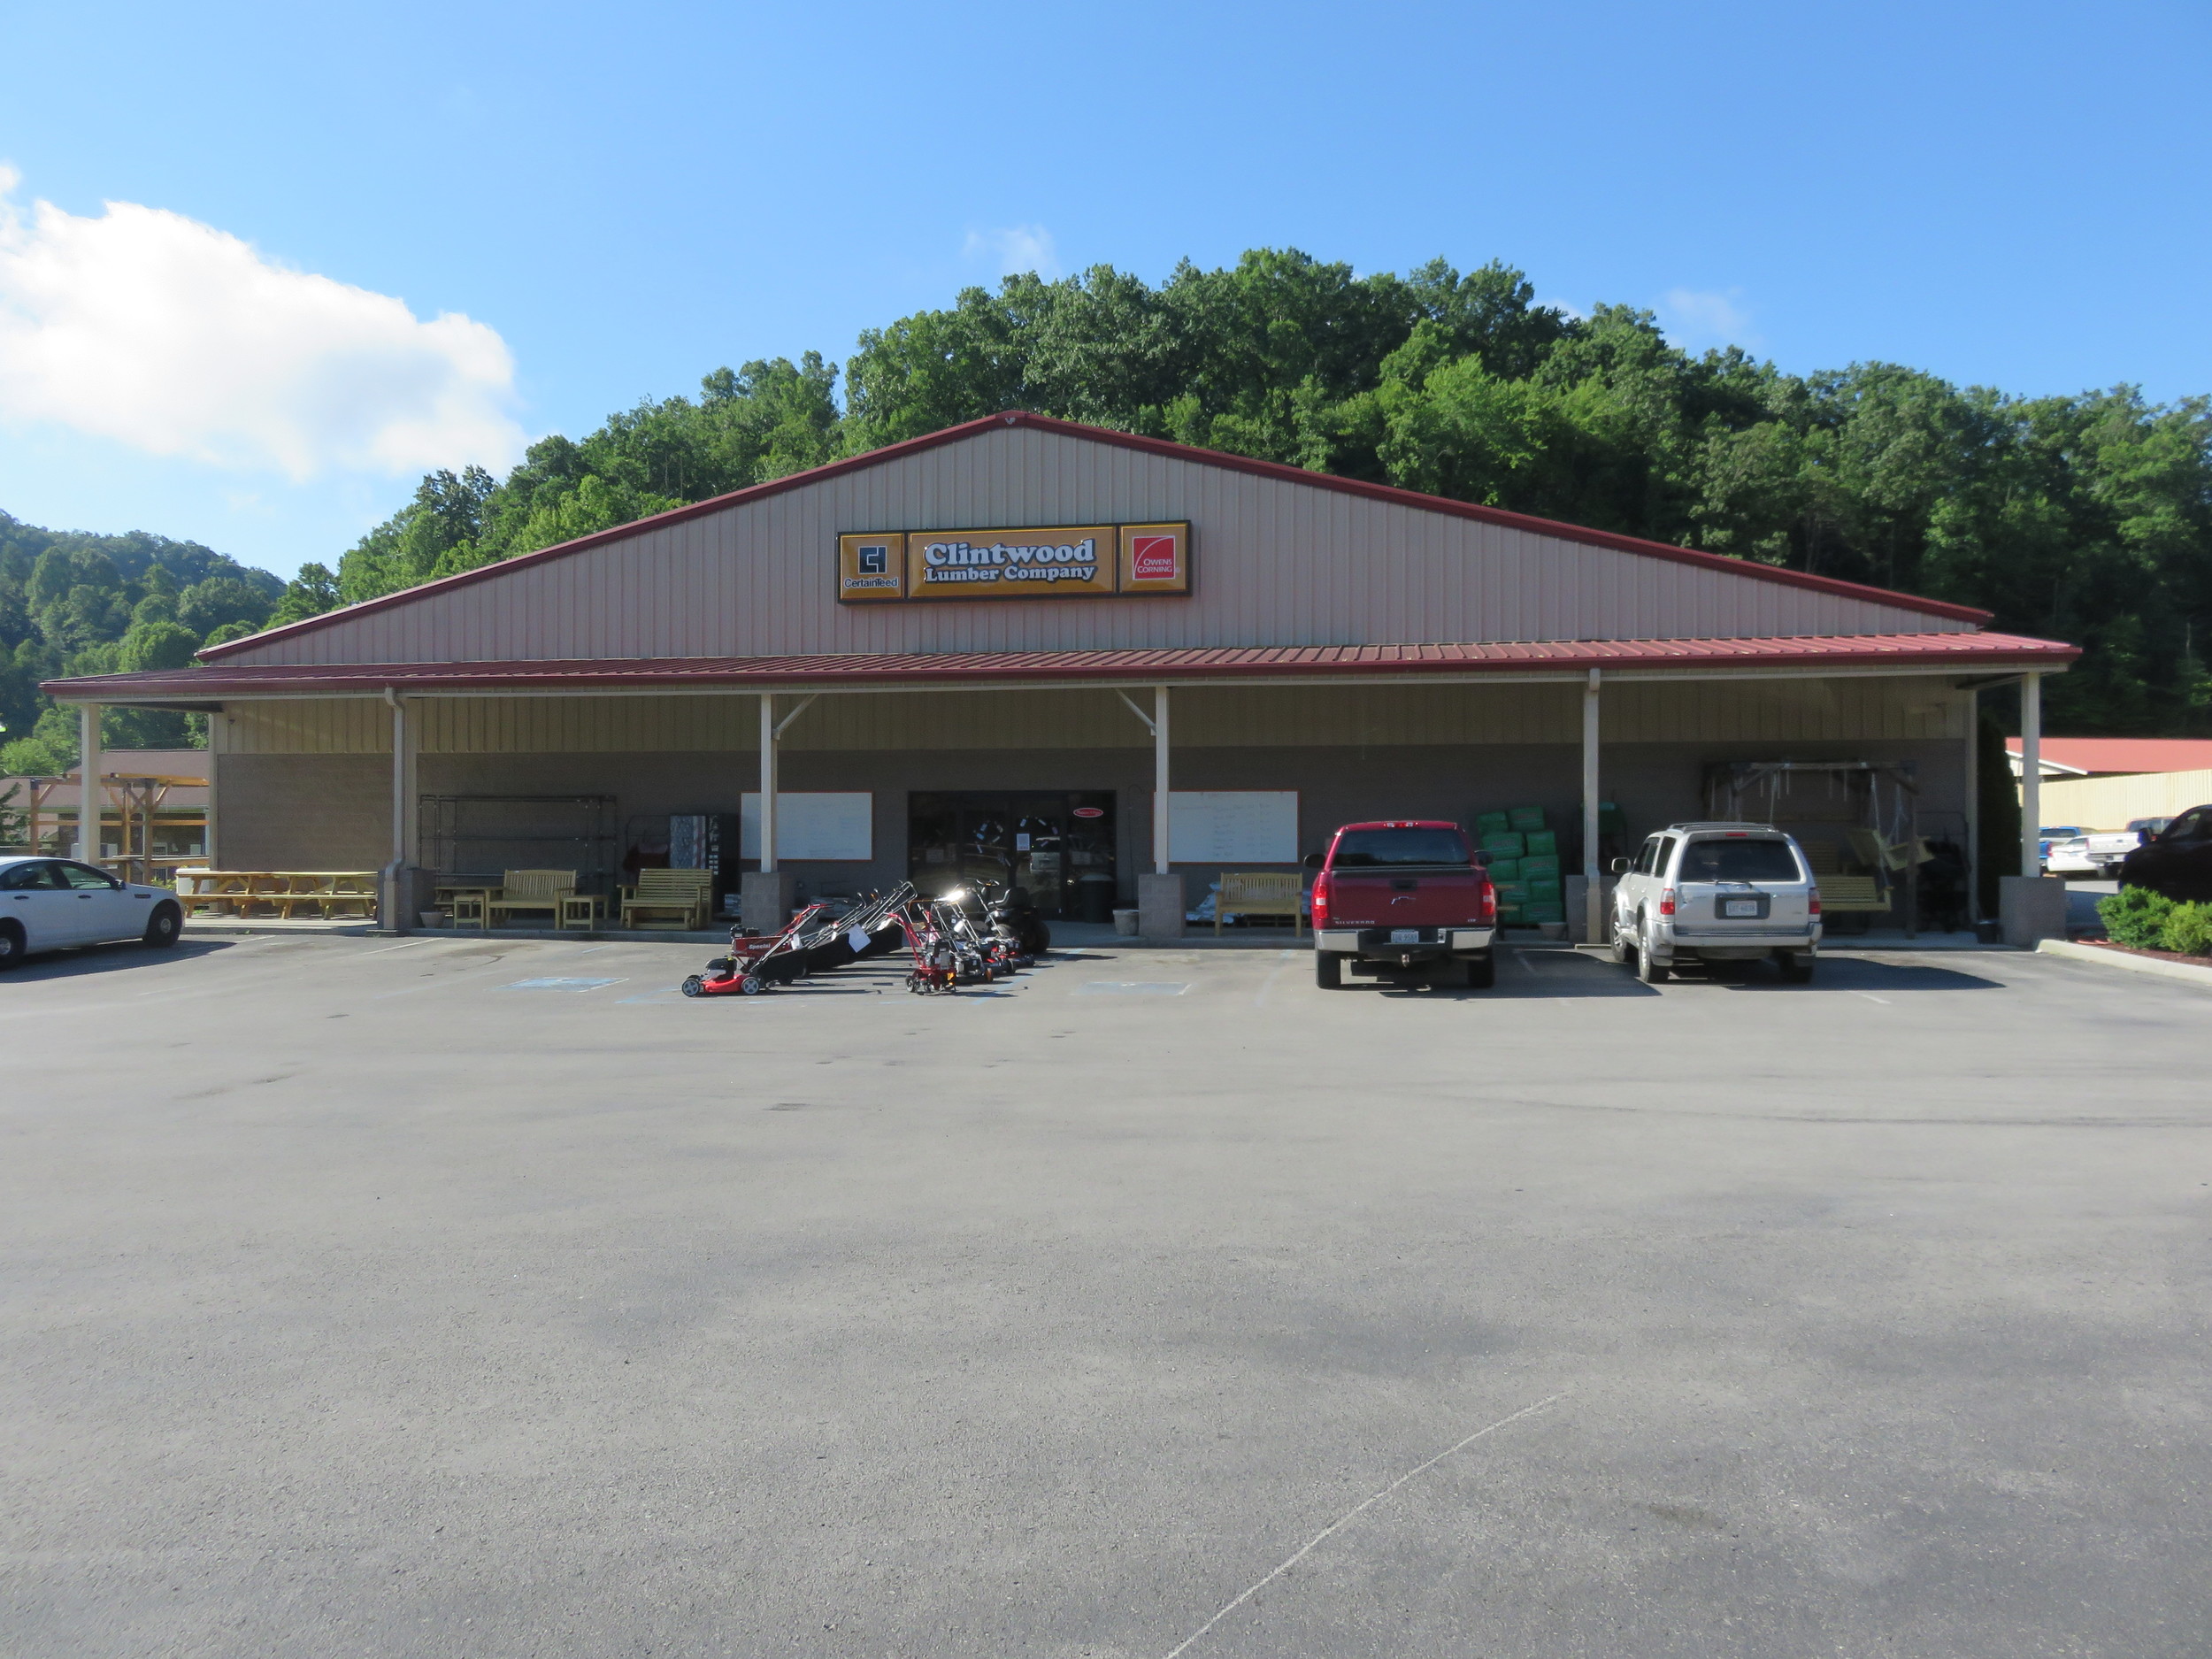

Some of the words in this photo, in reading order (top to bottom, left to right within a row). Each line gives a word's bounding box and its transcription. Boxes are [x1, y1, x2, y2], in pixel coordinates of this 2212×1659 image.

[925, 538, 1095, 567] Clintwood
[844, 576, 899, 588] CertainTeed
[925, 566, 1000, 583] Lumber
[1003, 565, 1096, 582] Company
